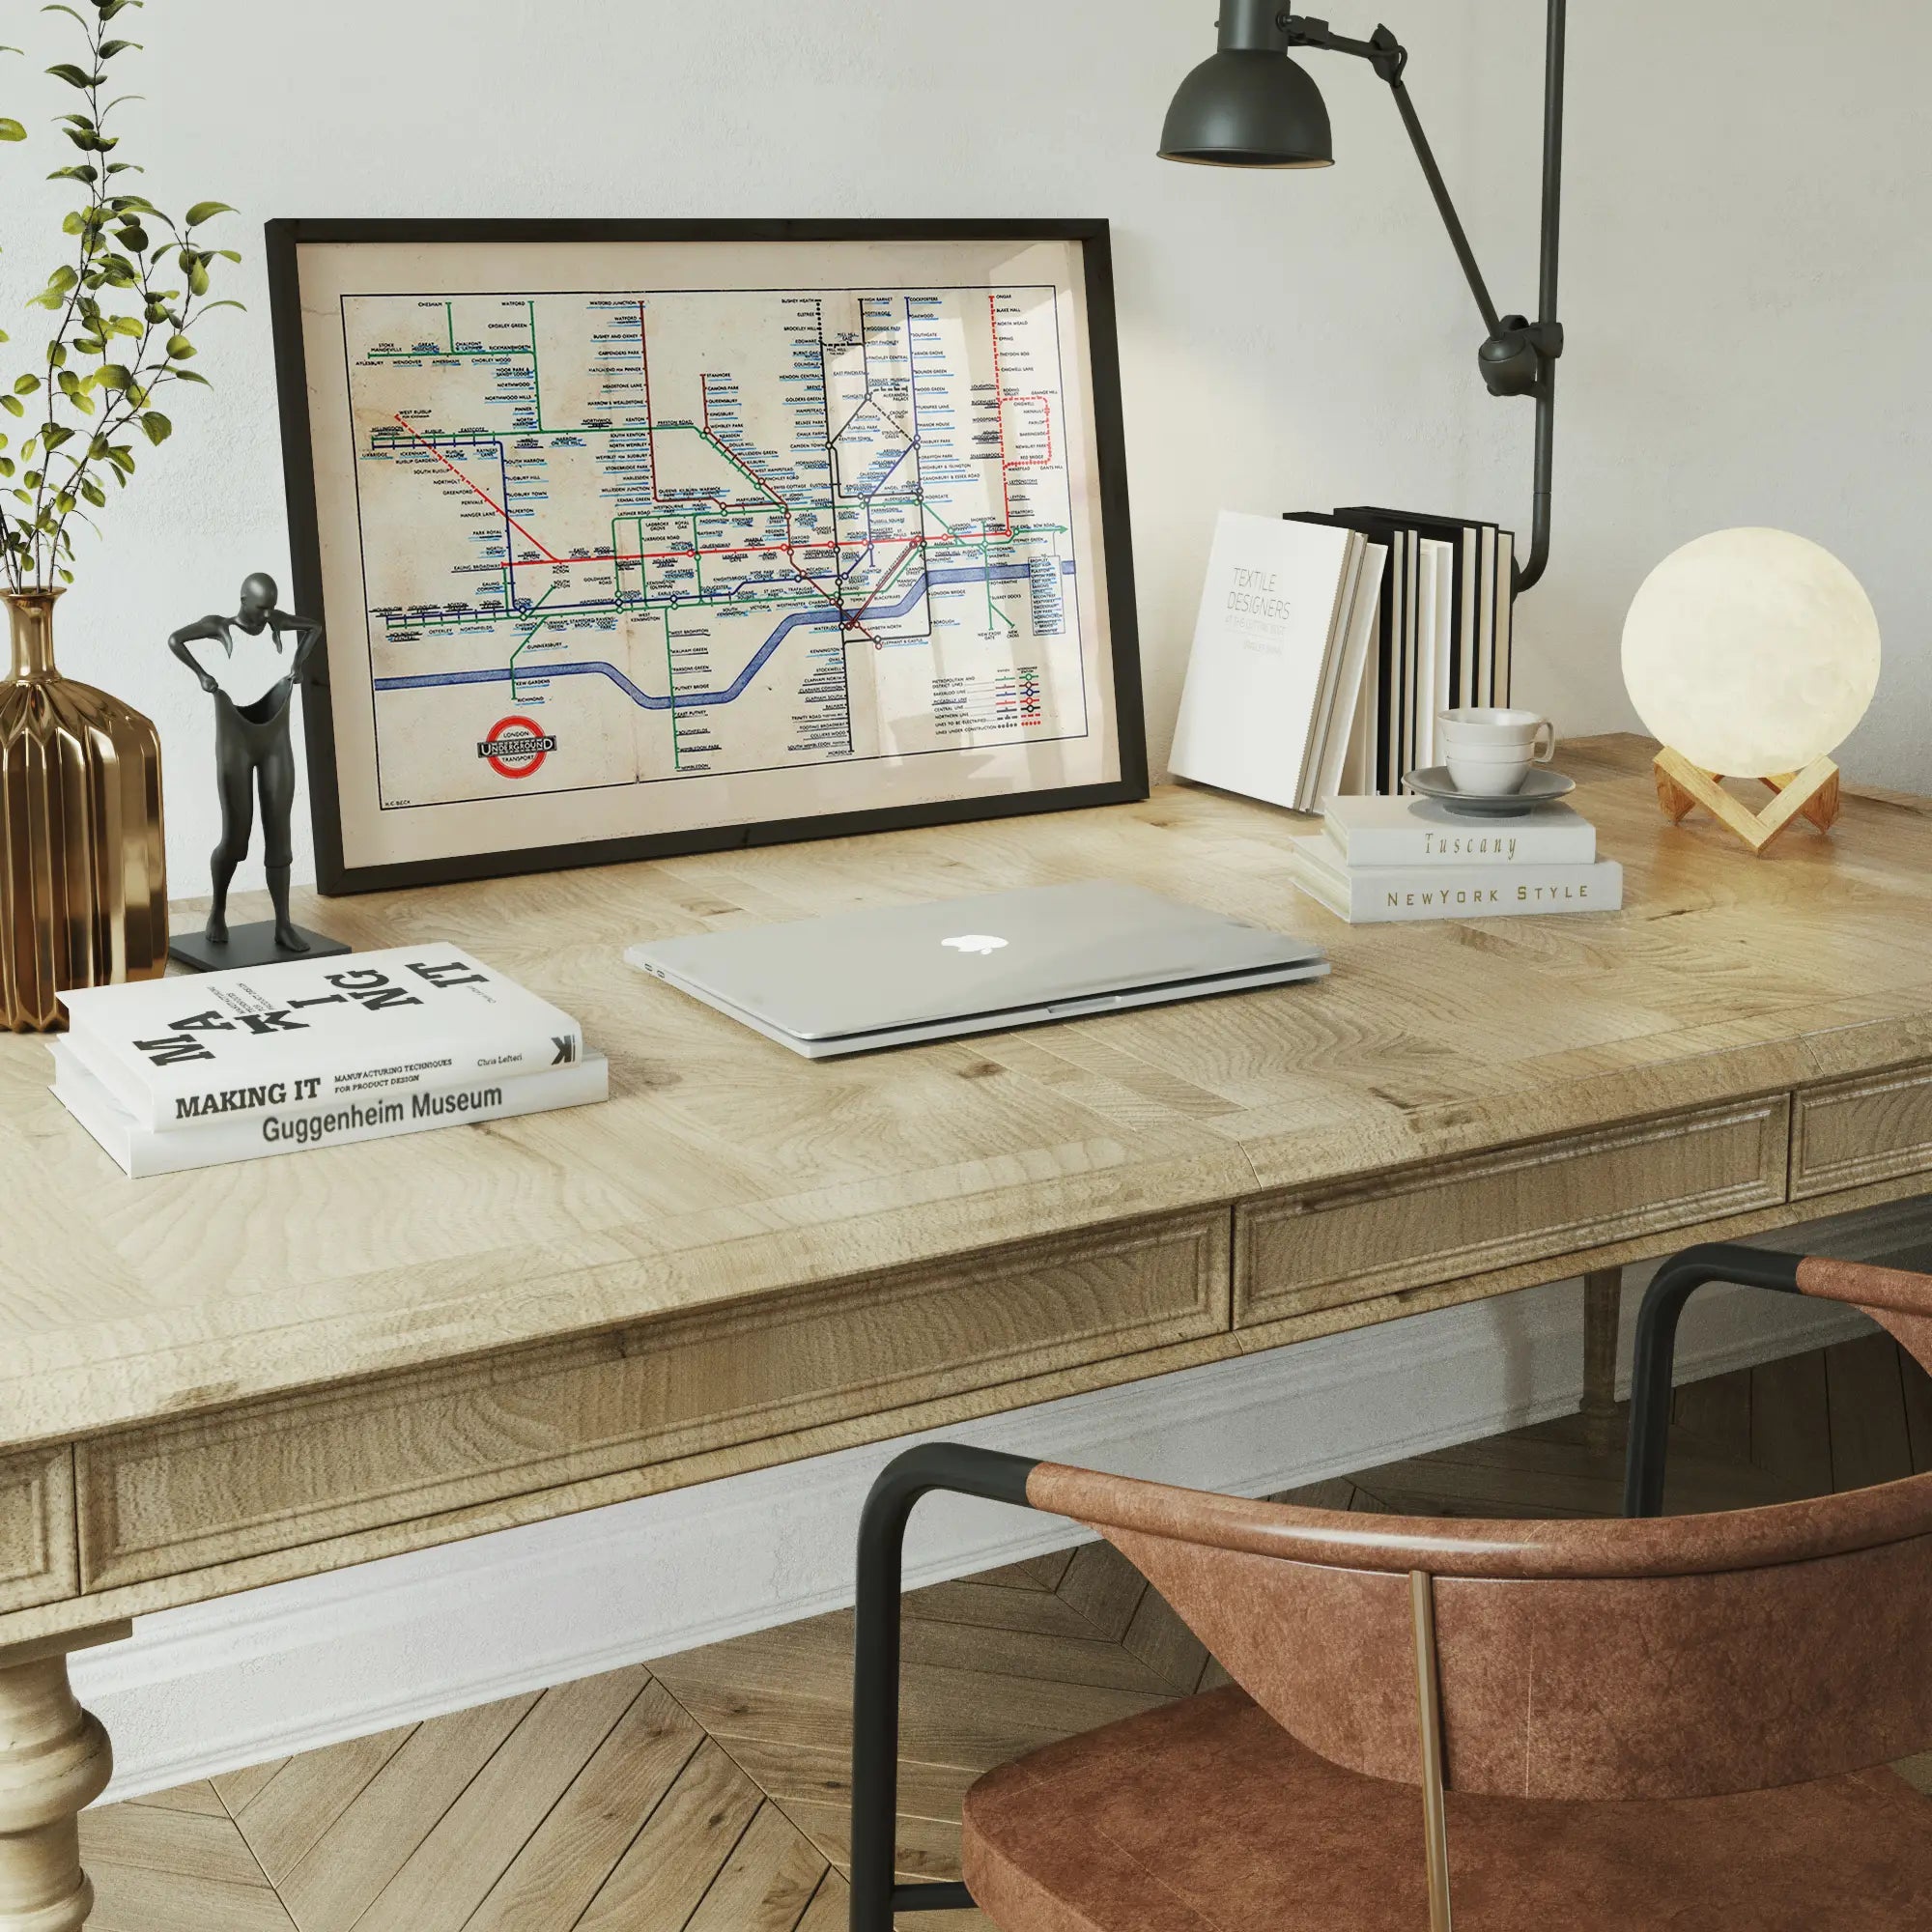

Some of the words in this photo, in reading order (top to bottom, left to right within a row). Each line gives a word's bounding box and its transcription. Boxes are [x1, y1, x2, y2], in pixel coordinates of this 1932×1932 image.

[1234, 567, 1277, 592] TEXTILE
[1226, 591, 1291, 620] DESIGNERS
[481, 738, 554, 755] UNDERGROUND
[1425, 833, 1517, 861] Tuscany
[1517, 885, 1588, 900] STYLE
[334, 1064, 403, 1083] MANUFACTURING
[404, 1058, 453, 1073] TECHNIQUES
[477, 1057, 497, 1066] Chris
[497, 1053, 523, 1065] Lefteri
[334, 1084, 351, 1094] FOR
[352, 1079, 389, 1092] PRODUCT
[390, 1074, 420, 1087] DESIGN
[175, 1083, 287, 1119] MAKING
[294, 1077, 322, 1101] IT
[263, 1098, 404, 1144] Guggenheim
[412, 1087, 503, 1119] Museum
